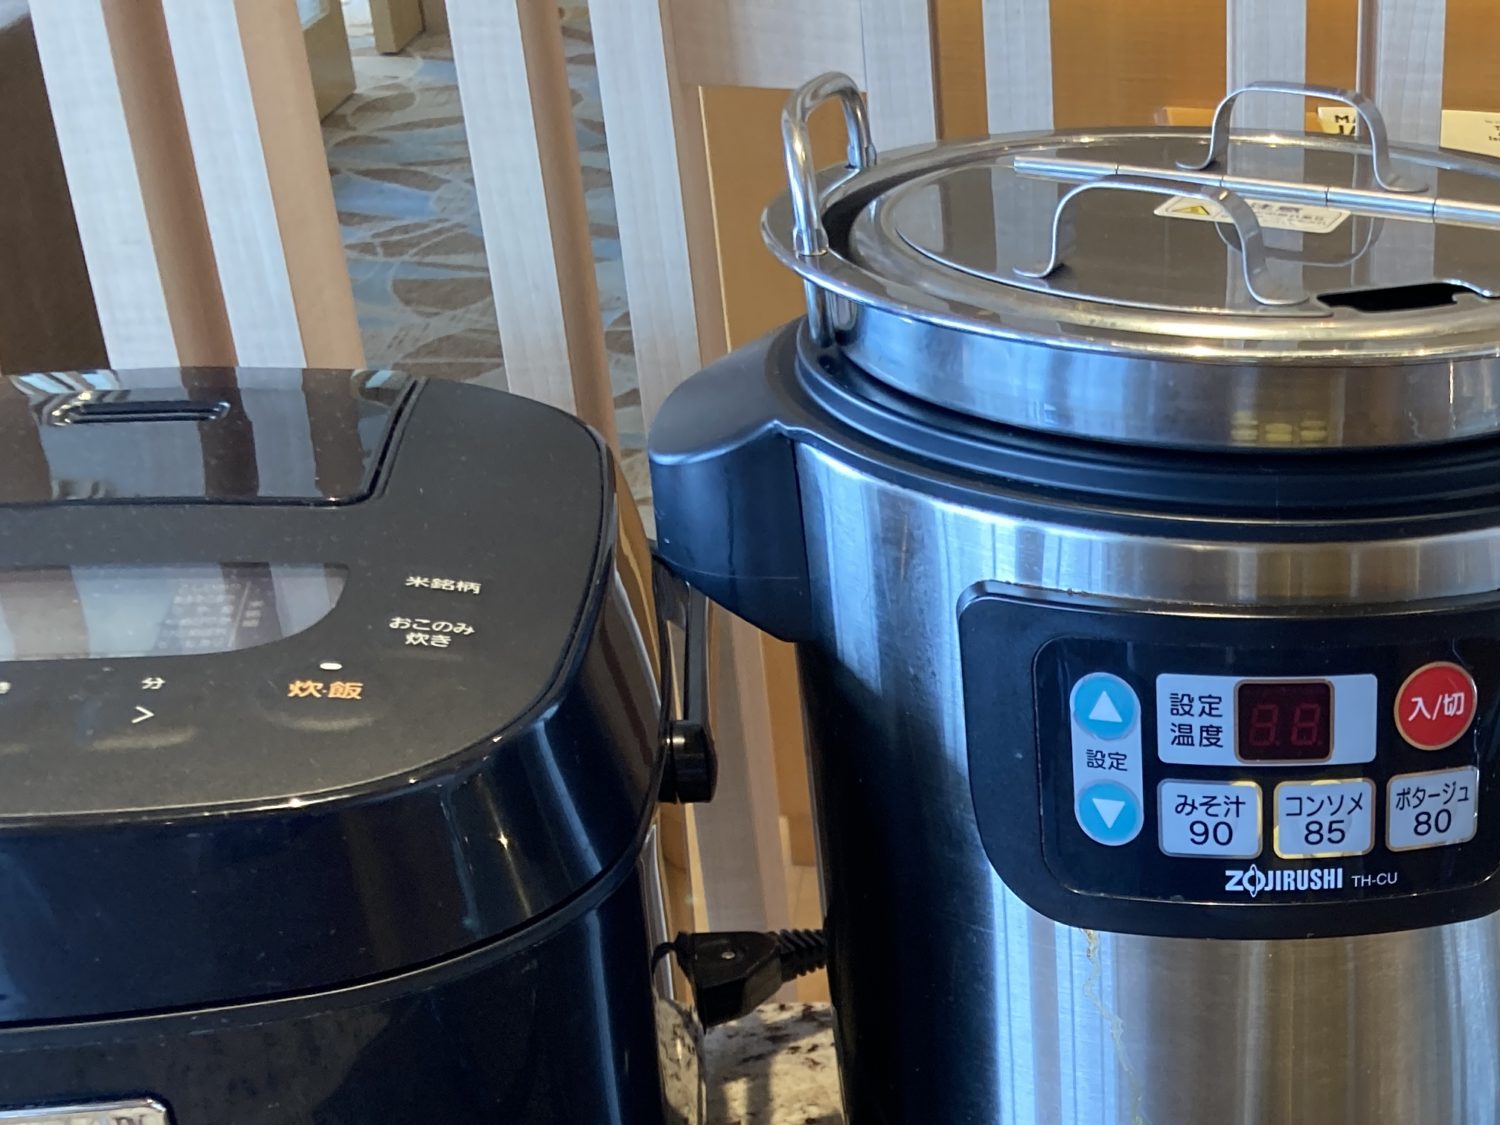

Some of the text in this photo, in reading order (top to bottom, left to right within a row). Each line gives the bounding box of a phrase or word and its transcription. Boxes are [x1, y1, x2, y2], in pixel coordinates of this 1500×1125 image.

[405, 576, 481, 594] 米銘柄
[389, 617, 475, 635] おこのみ
[405, 632, 452, 647] 炊き
[141, 677, 166, 690] 分
[288, 680, 363, 699] 炊飯
[1169, 692, 1223, 718] 設定
[1408, 692, 1465, 721] 入/切
[1170, 723, 1224, 748] 温度
[1086, 750, 1128, 772] 設定
[1174, 794, 1246, 818] みそ汁
[1285, 793, 1363, 817] コンソメ
[1395, 781, 1470, 811] ポタージュ
[1189, 820, 1233, 846] 90
[1304, 820, 1346, 845] 85
[1413, 808, 1452, 836] 80
[1224, 863, 1398, 898] ZOJIRUSHI TH-CU
